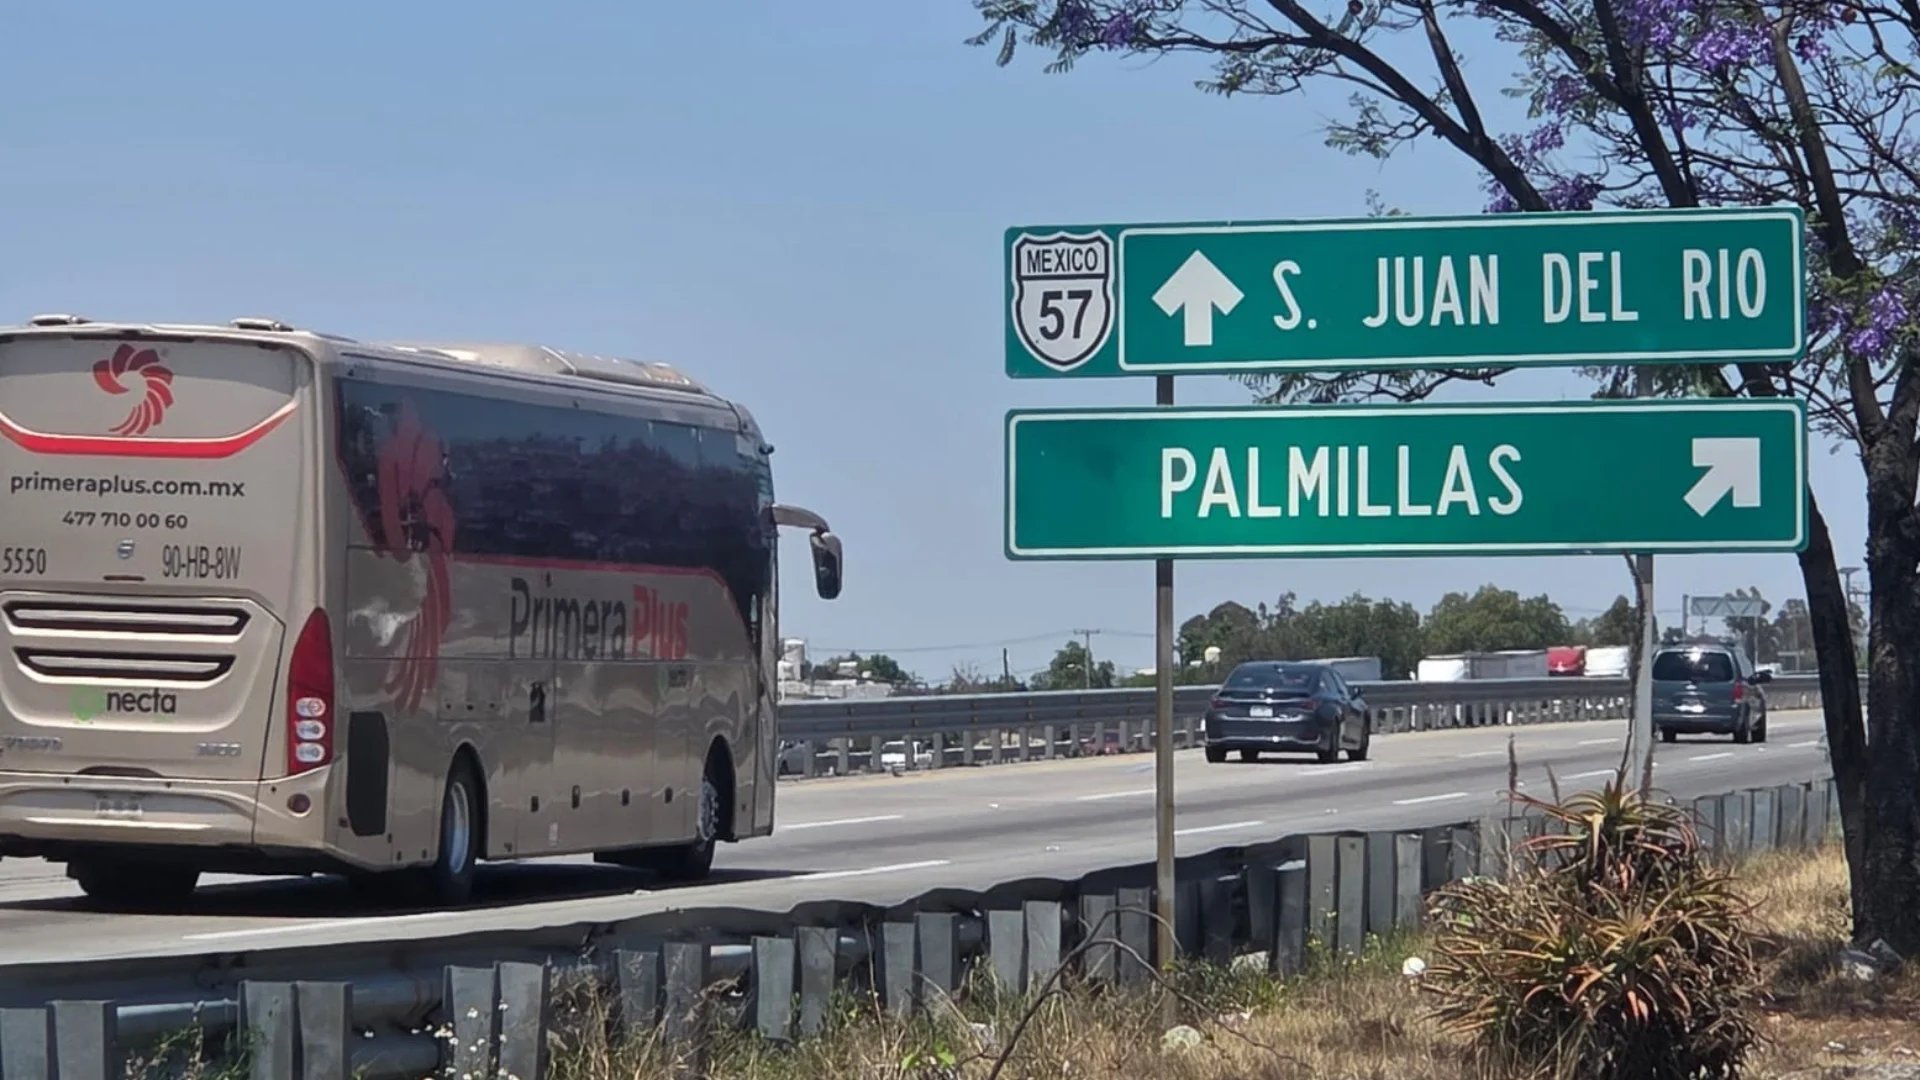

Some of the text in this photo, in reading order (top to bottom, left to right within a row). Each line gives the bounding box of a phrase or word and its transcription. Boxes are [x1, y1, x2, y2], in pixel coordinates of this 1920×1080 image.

[1027, 247, 1098, 273] MEXICO
[1273, 248, 1767, 330] S. JUAN DEL RIO
[1039, 289, 1093, 340] 57
[10, 471, 245, 498] primeraplus.com.mx
[1161, 444, 1524, 518] PALMILLAS
[62, 510, 188, 529] 477 710 00 60
[3, 547, 47, 575] 5550
[162, 544, 241, 579] 90-HB-8W
[107, 687, 177, 714] necta
